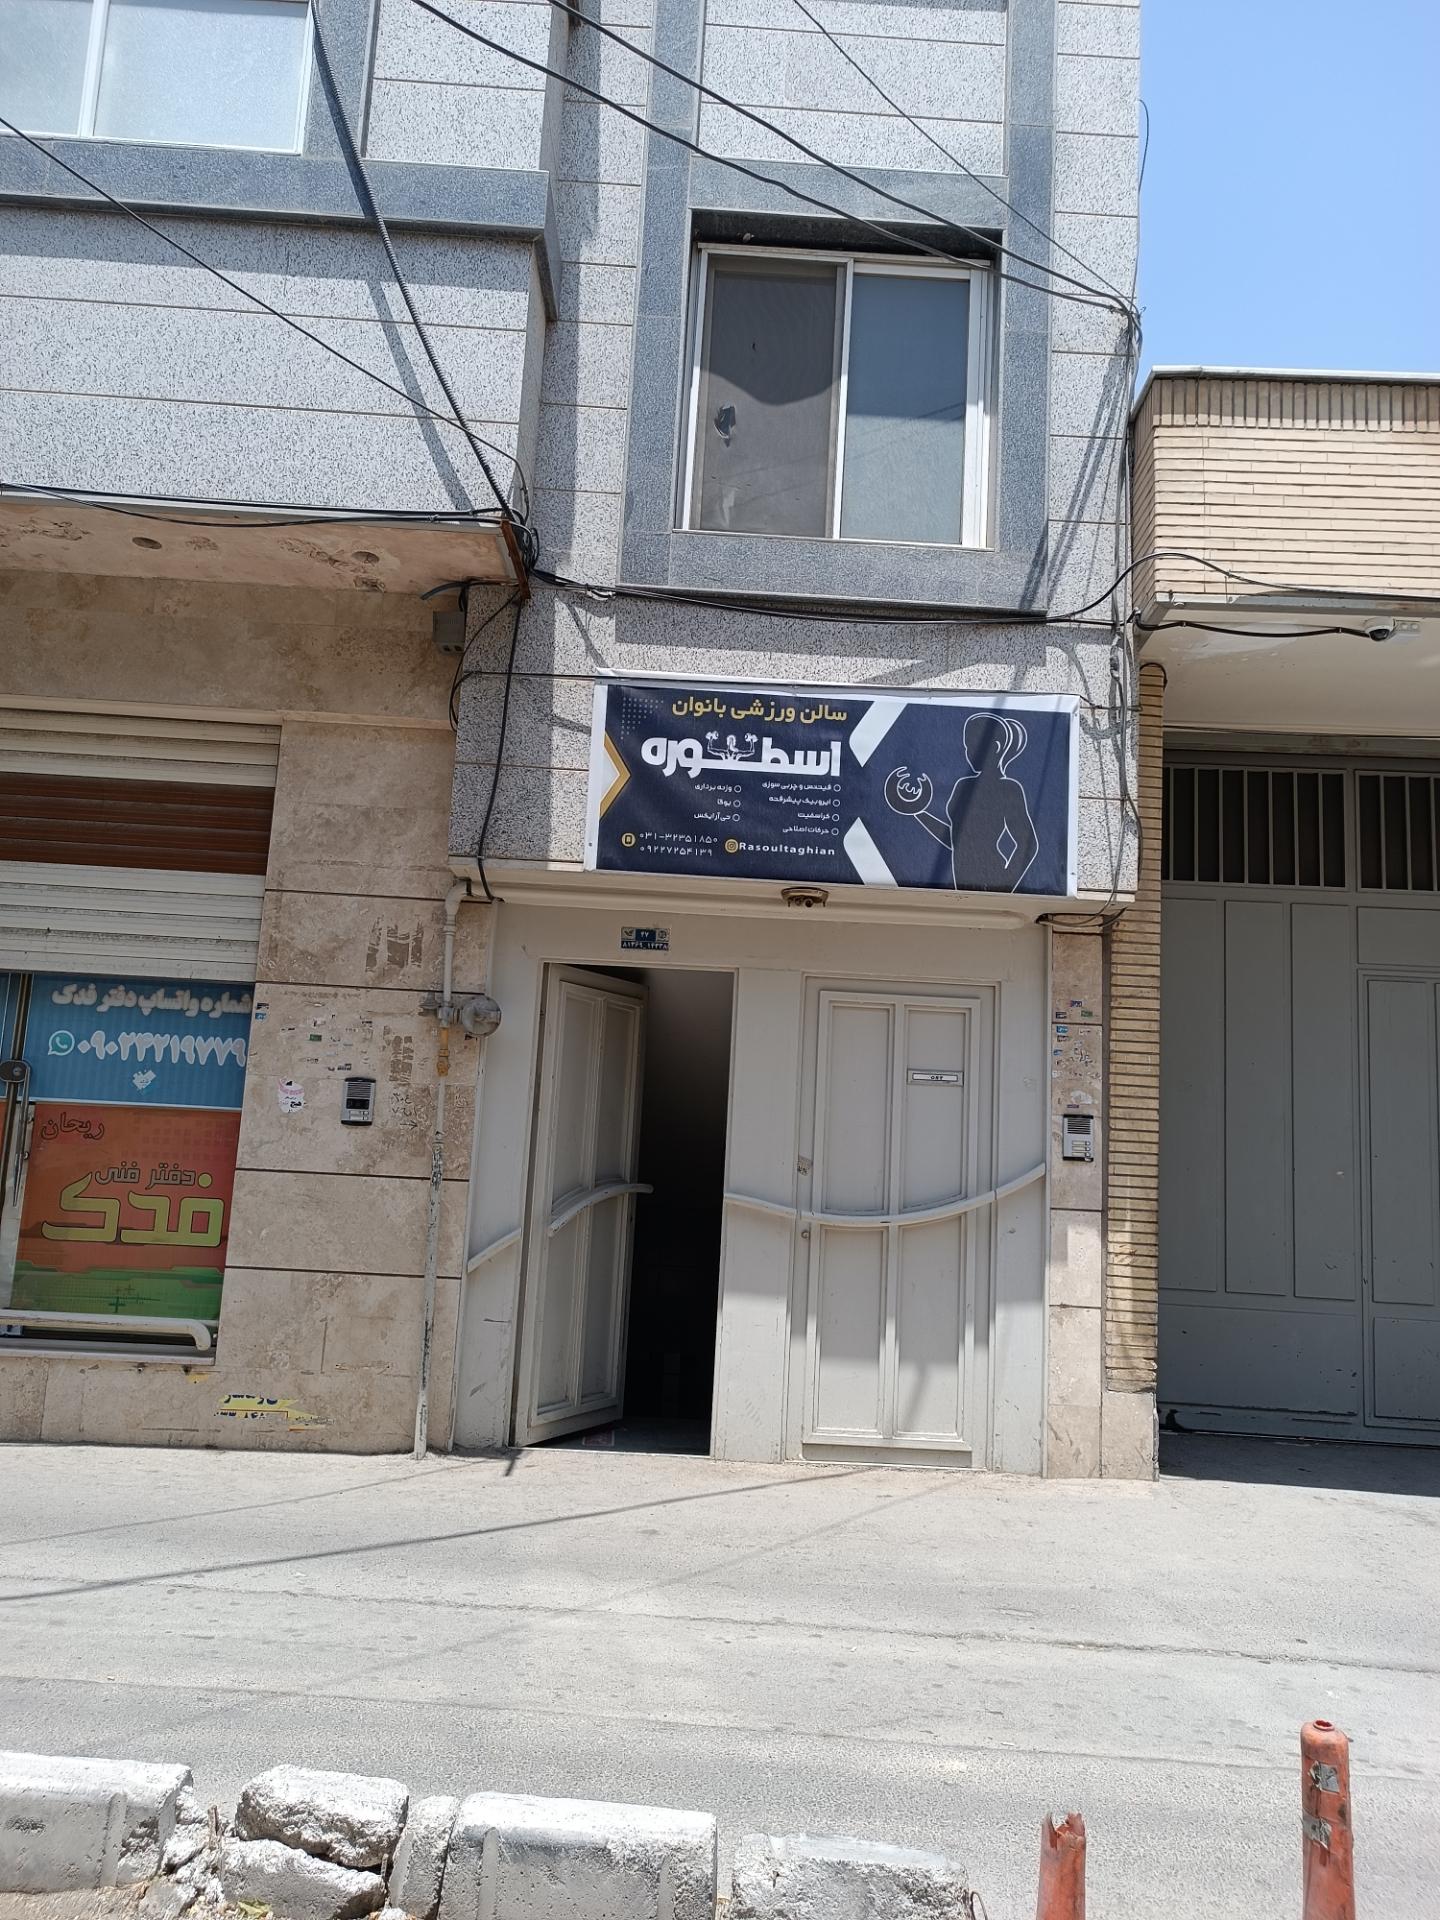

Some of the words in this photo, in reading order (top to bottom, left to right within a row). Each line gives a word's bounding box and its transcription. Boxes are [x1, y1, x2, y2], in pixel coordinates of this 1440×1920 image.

[672, 696, 726, 718] بانوان
[731, 698, 796, 722] ورزشی
[800, 704, 847, 724] سالن
[641, 736, 842, 779] اسطوره
[694, 783, 716, 792] برداری
[717, 784, 732, 793] وزنه
[762, 780, 781, 789] سوزی
[781, 782, 798, 791] چربی
[717, 798, 732, 807] یوگا
[769, 796, 802, 806] پیشرفته
[782, 825, 808, 833] اصلاحی
[740, 842, 835, 856] Rasoultaghian
[52, 983, 97, 1006] فدک
[96, 984, 137, 1012] دفتر
[138, 988, 200, 1016] واتساپ
[200, 991, 250, 1018] شماره
[40, 1112, 105, 1140] ریحان
[95, 1161, 141, 1185] فنی
[145, 1163, 197, 1190] دفتر
[41, 1172, 225, 1247] فدک
